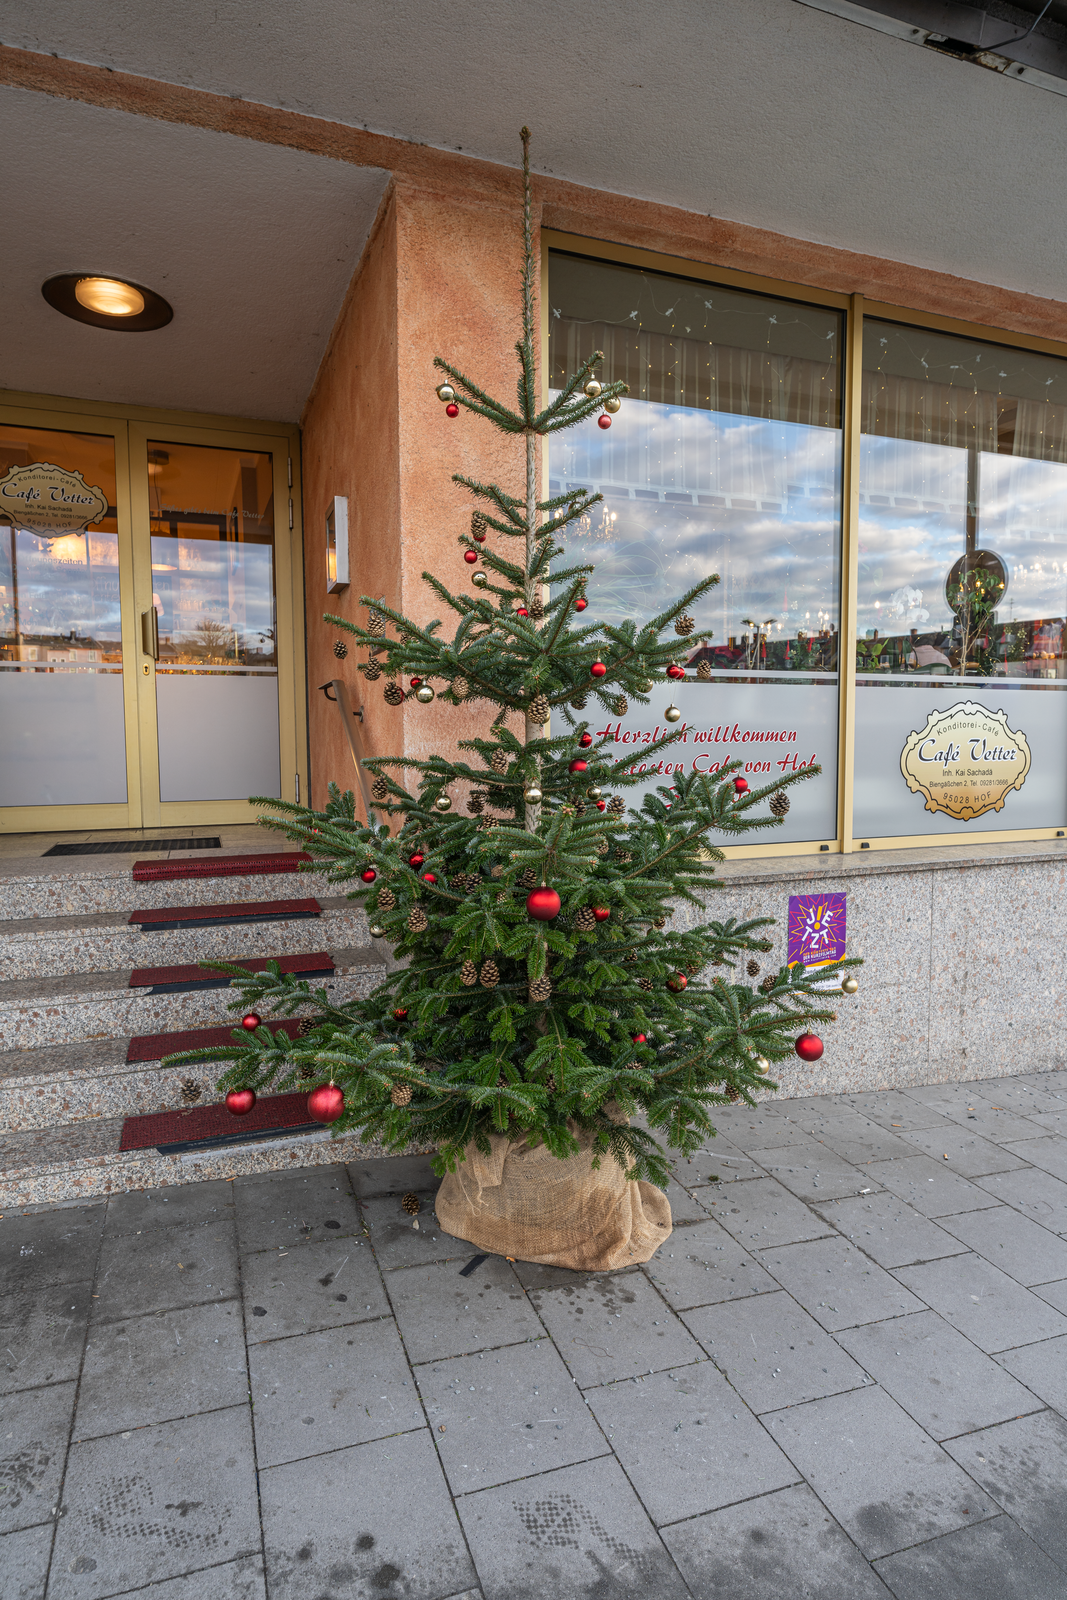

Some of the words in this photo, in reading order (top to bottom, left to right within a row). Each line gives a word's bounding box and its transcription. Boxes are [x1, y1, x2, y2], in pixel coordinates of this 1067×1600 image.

[1, 482, 41, 503] Café
[47, 486, 95, 505] Vetter
[693, 722, 798, 744] willkommen
[918, 738, 961, 768] Café
[968, 737, 1017, 761] Vetter
[744, 760, 771, 774] von
[955, 769, 966, 777] Kai
[942, 792, 970, 804] 95028
[974, 790, 992, 803] HOF
